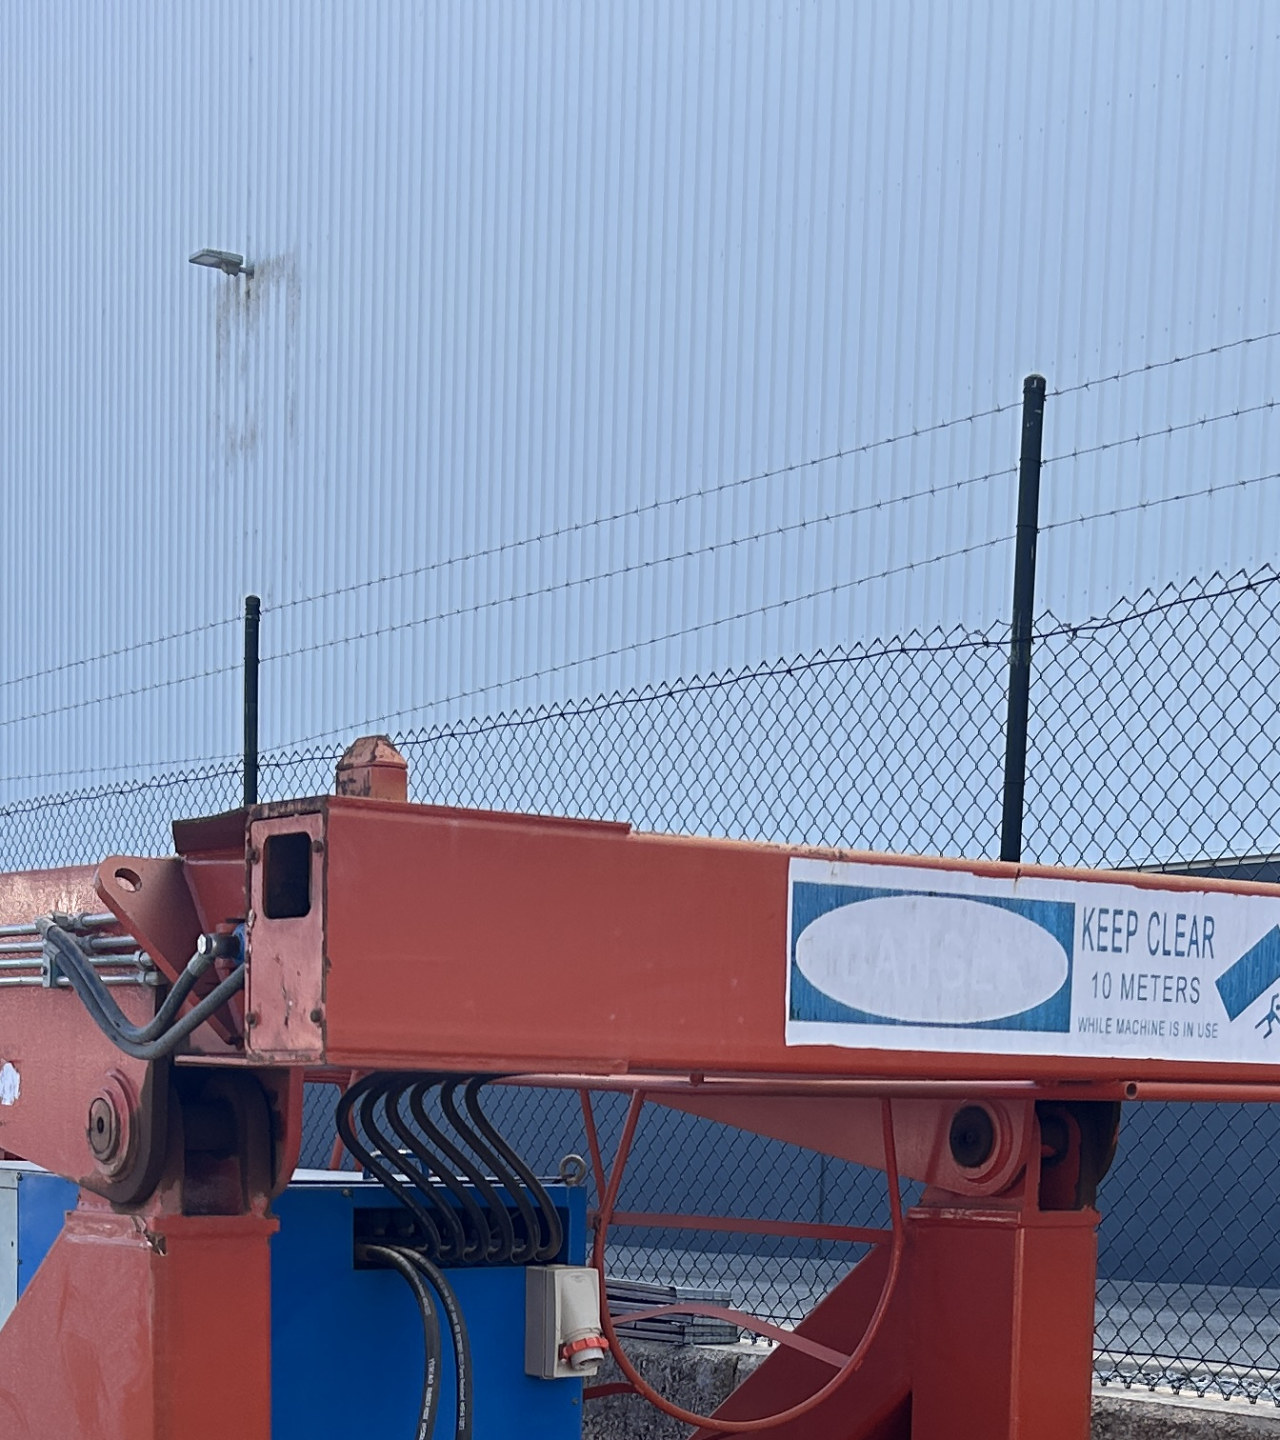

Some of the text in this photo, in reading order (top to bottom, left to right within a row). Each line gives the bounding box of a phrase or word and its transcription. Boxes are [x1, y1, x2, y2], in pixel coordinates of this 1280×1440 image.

[1082, 906, 1216, 960] KEEP CLEAR
[1091, 970, 1201, 1005] 10 METERS
[1077, 1015, 1219, 1039] WHILE MACHINE IS IN USE
